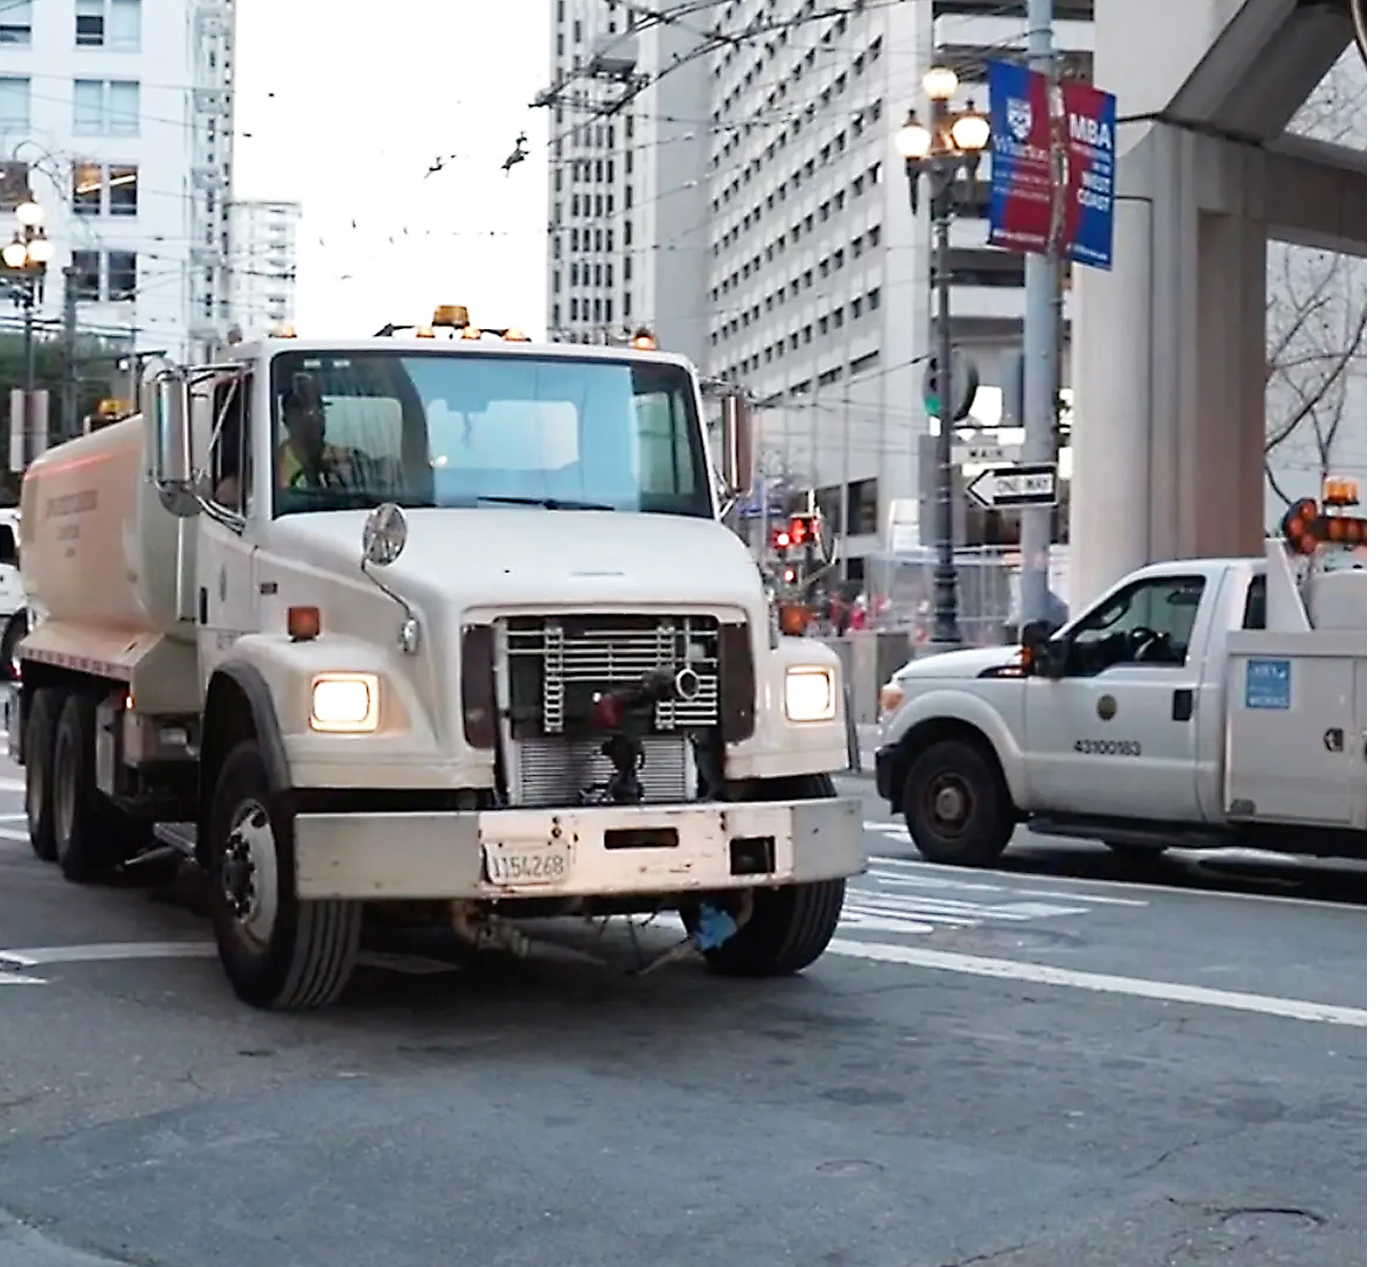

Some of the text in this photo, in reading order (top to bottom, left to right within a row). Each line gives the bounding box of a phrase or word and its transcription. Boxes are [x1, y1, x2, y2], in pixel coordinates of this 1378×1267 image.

[1069, 113, 1111, 149] MBA
[995, 477, 1051, 492] ONE WAY
